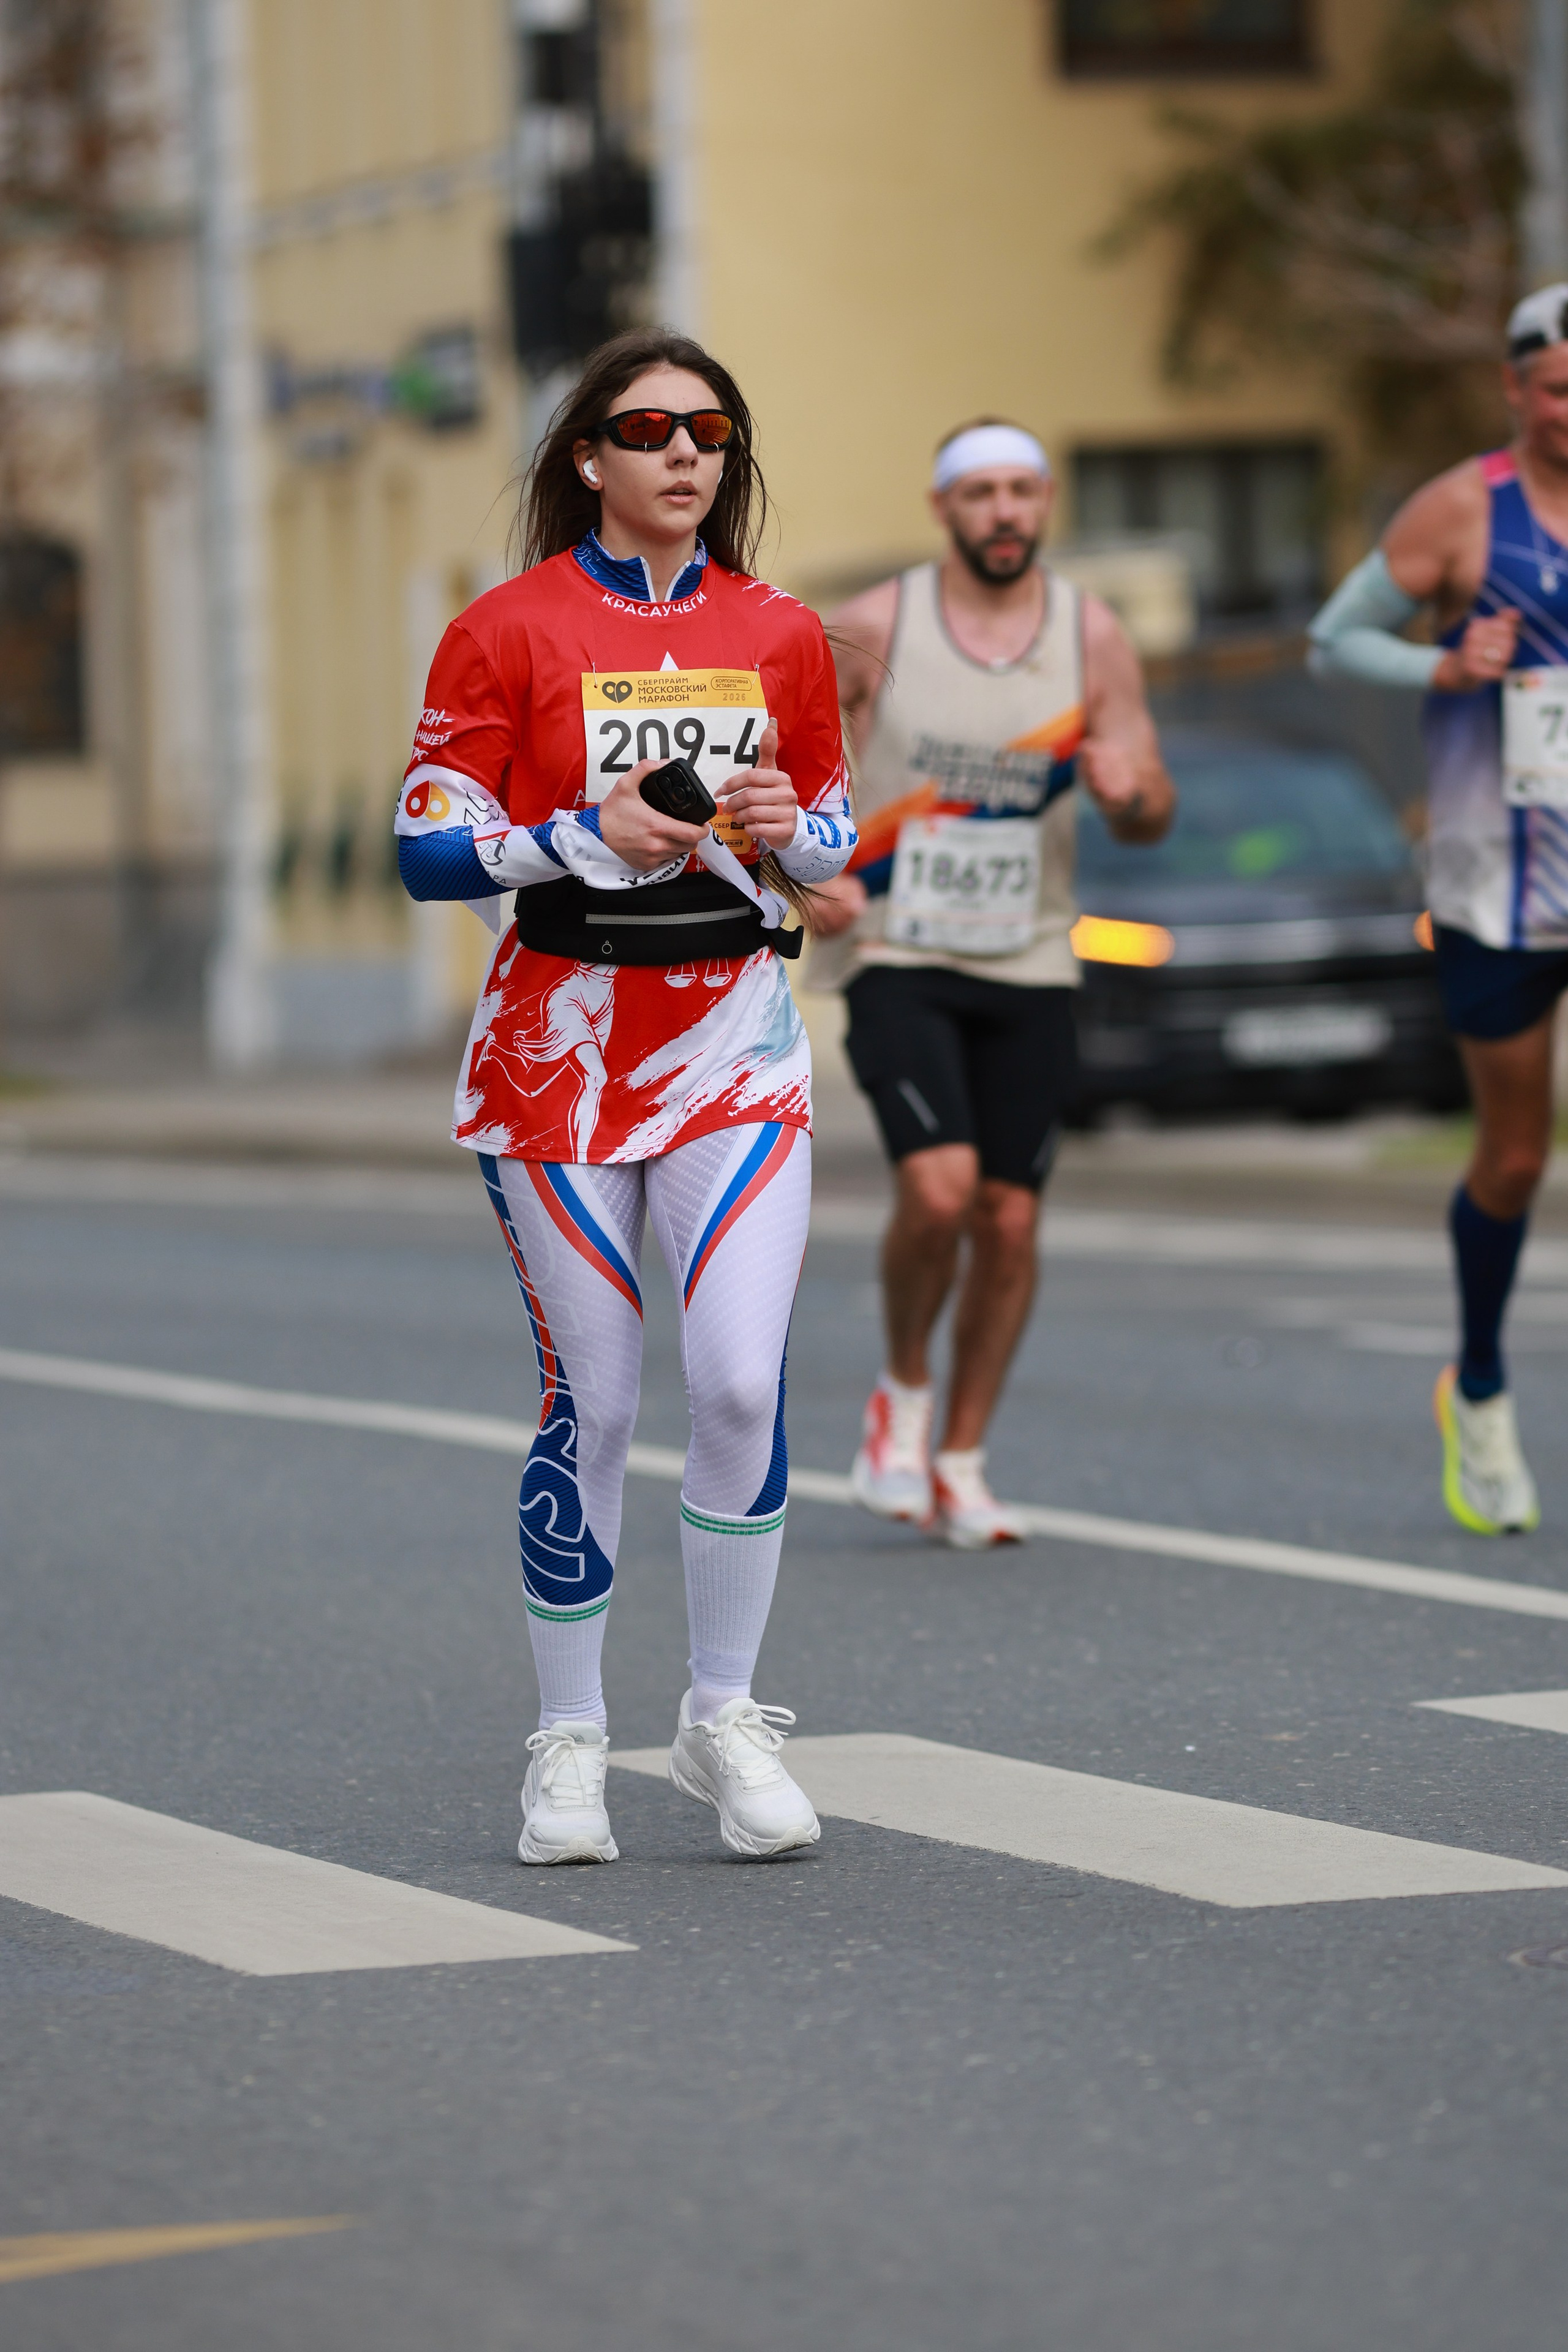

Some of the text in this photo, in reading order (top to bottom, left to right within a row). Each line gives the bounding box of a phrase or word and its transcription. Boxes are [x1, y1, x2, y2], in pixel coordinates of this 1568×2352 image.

[601, 590, 707, 617] КРАСАУЧЕГИ
[638, 684, 707, 695] МОСКОВСКИЙ
[639, 694, 689, 703] МАРАФОН
[723, 693, 746, 701] 2026
[599, 717, 759, 773] 209-4
